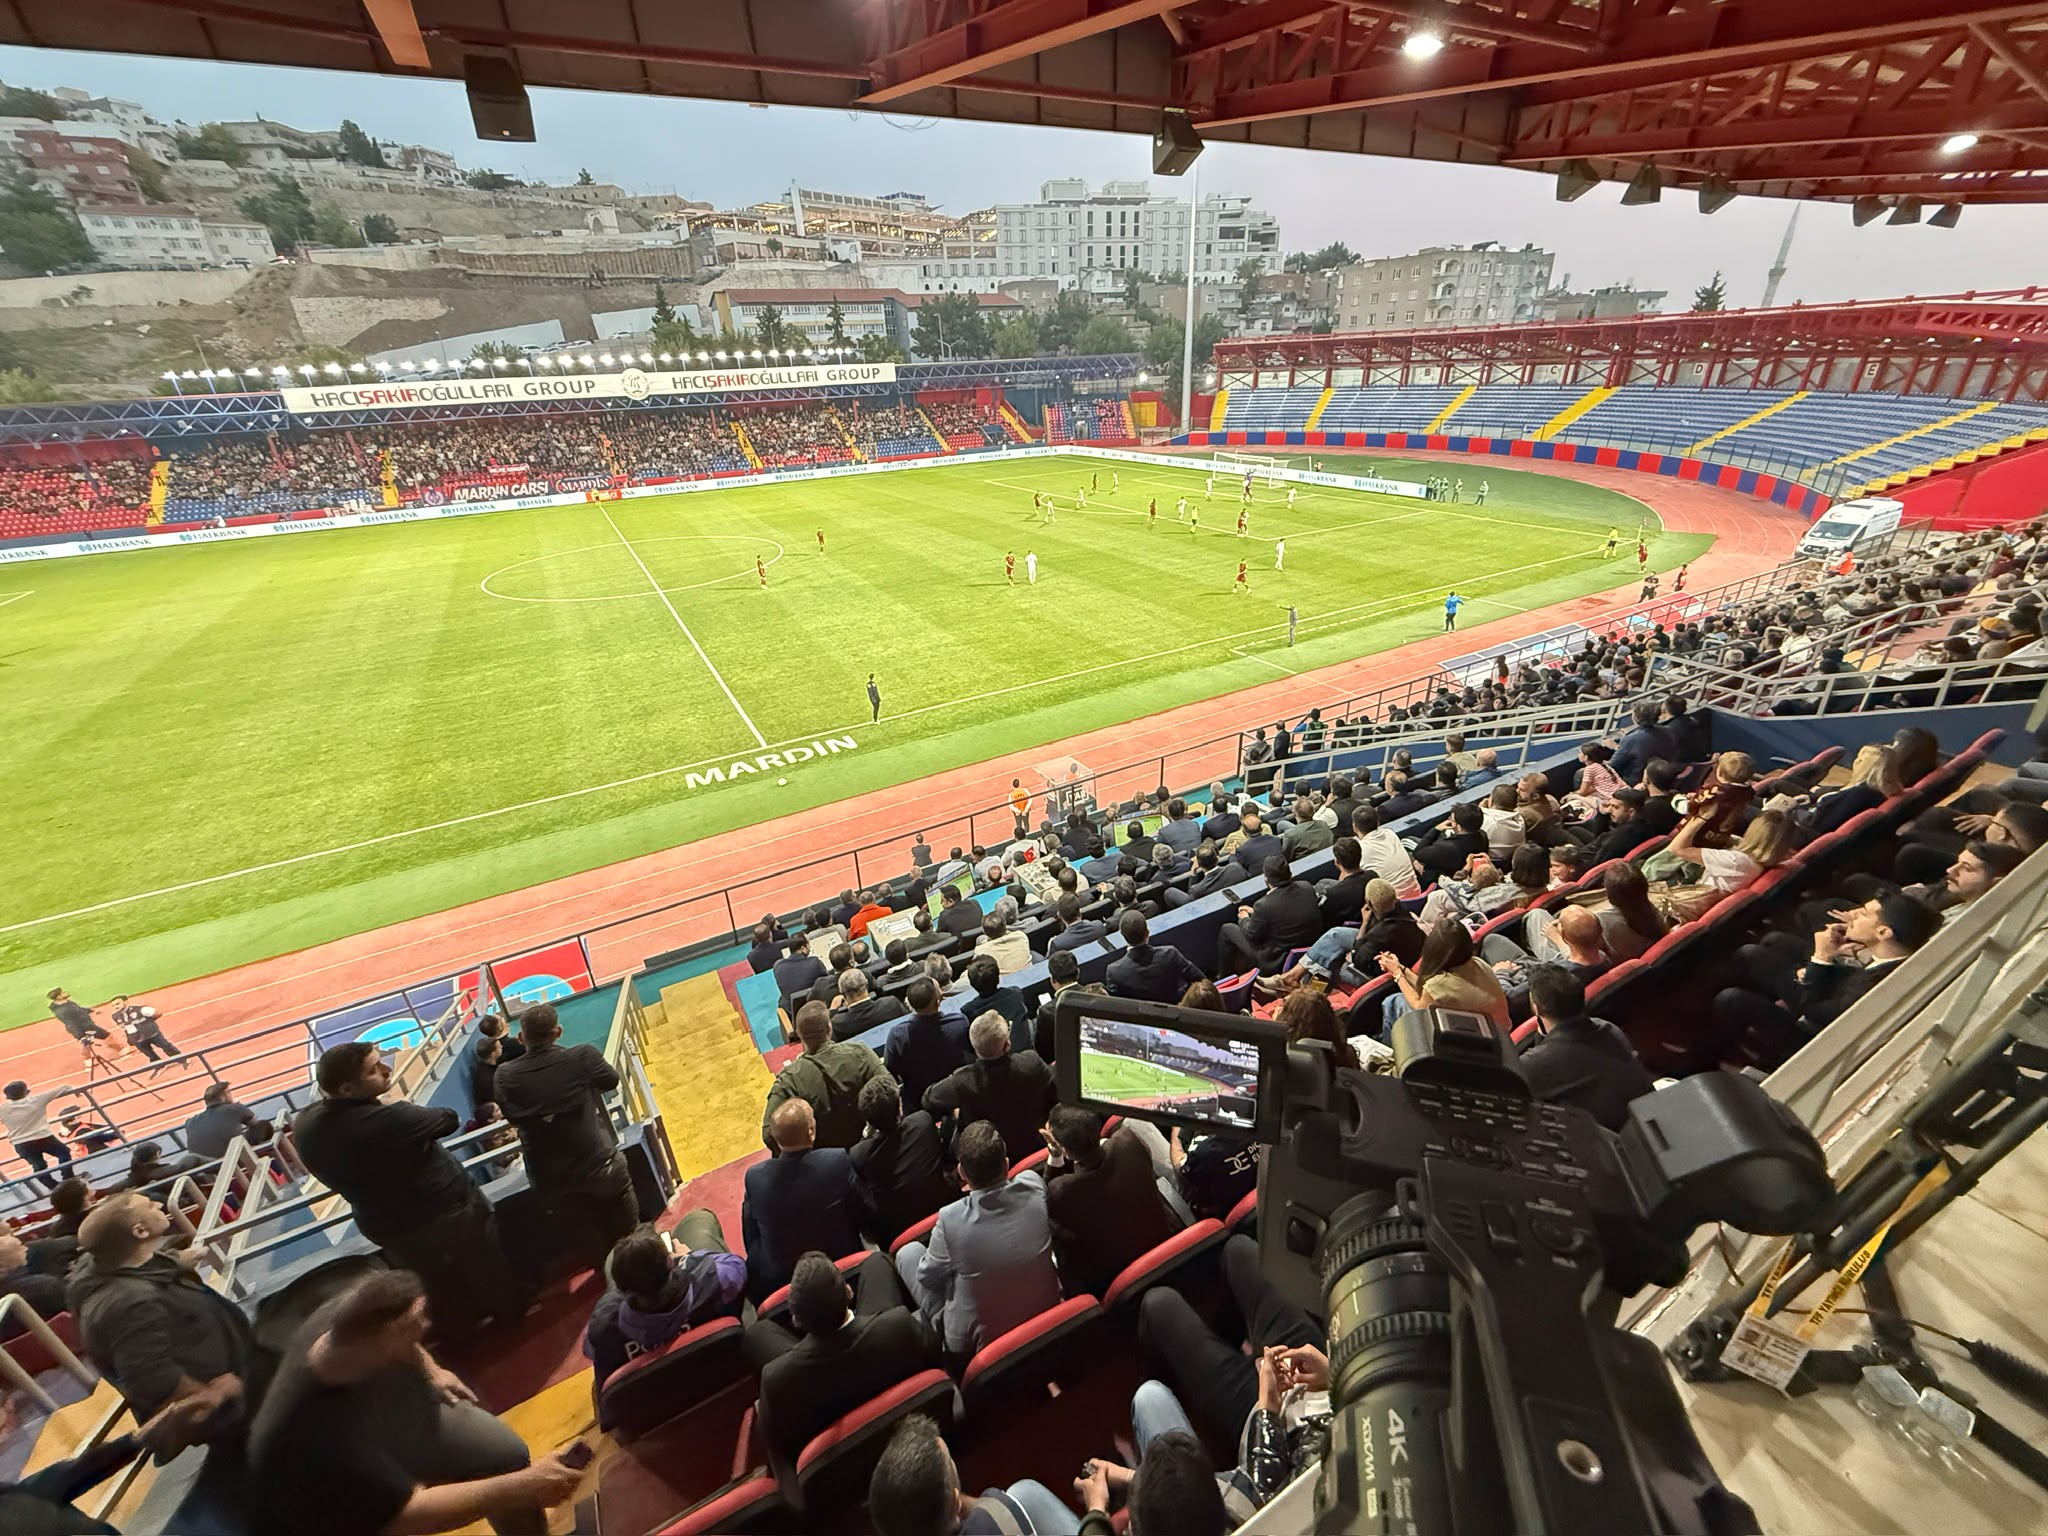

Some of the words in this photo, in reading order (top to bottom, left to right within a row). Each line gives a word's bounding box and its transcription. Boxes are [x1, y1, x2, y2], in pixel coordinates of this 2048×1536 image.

[826, 367, 881, 382] GROUP
[1424, 368, 1431, 377] B
[1550, 365, 1558, 375] C
[1695, 364, 1704, 374] D
[1867, 364, 1877, 376] E
[1272, 372, 1279, 381] A
[523, 379, 596, 396] GROUP
[684, 735, 859, 789] MARDIN
[1387, 1408, 1409, 1467] 4K
